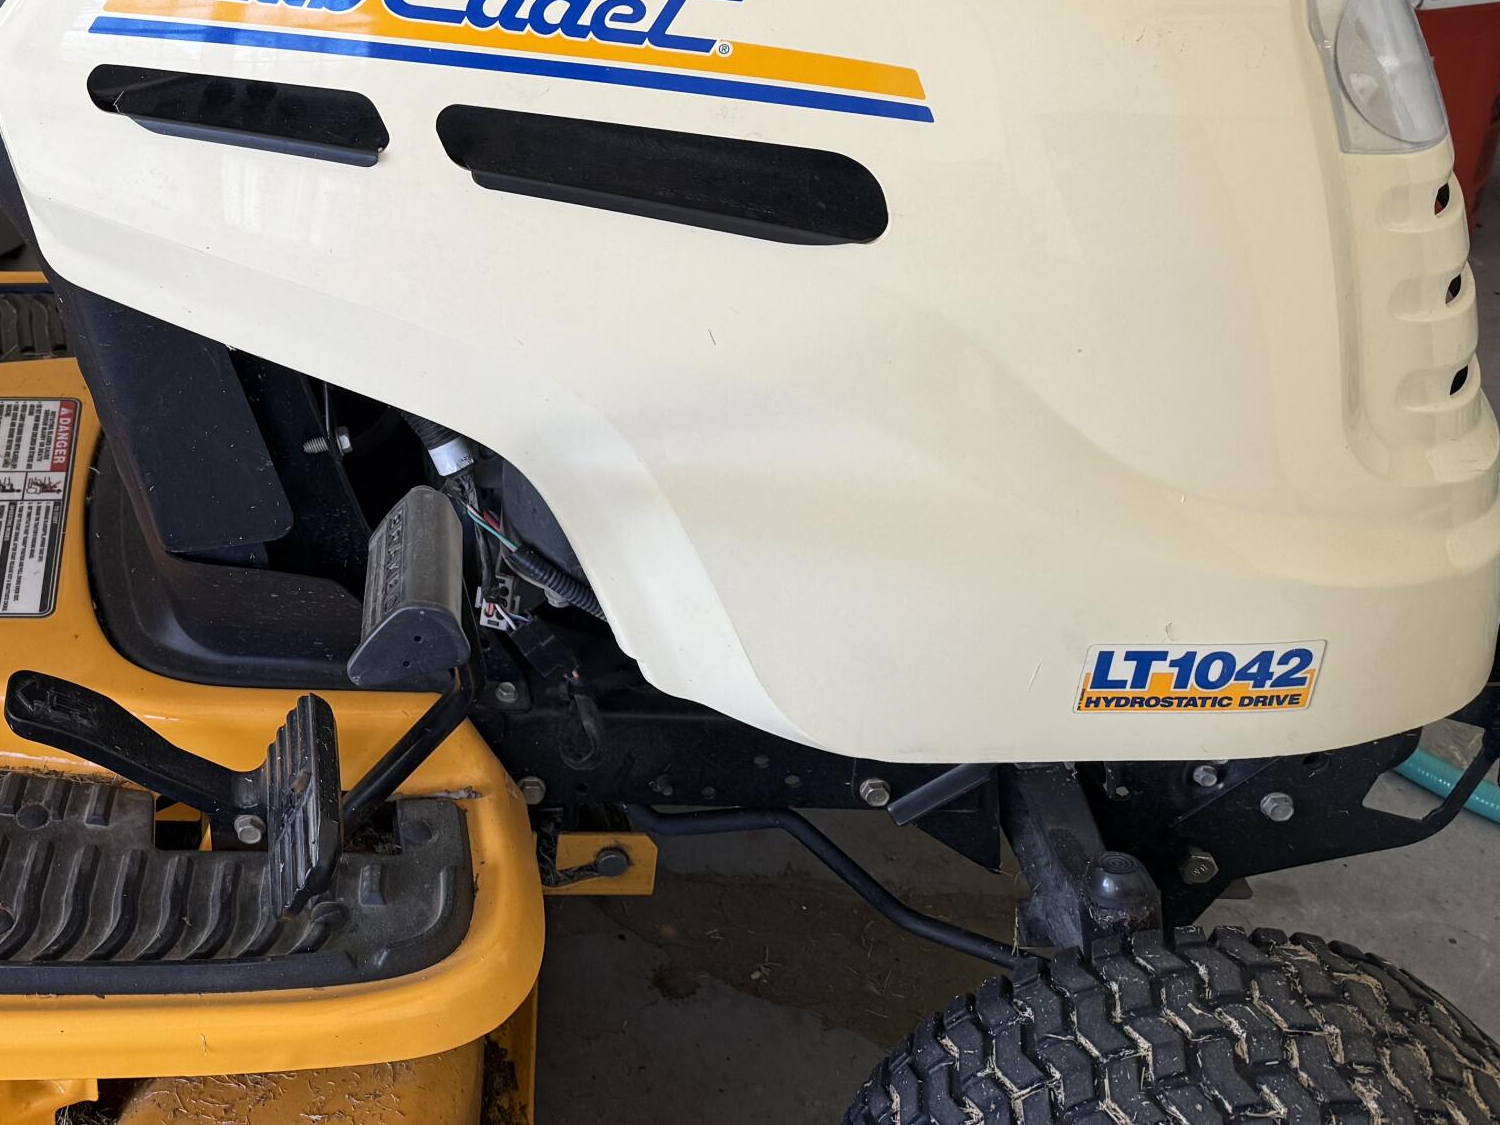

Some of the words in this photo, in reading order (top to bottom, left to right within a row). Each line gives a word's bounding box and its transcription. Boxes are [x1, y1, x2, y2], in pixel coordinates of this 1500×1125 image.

[52, 416, 71, 464] DANGER
[1089, 648, 1314, 690] LT1042
[1084, 695, 1236, 708] HYDROSTATIC
[1238, 693, 1302, 708] DRIVE
